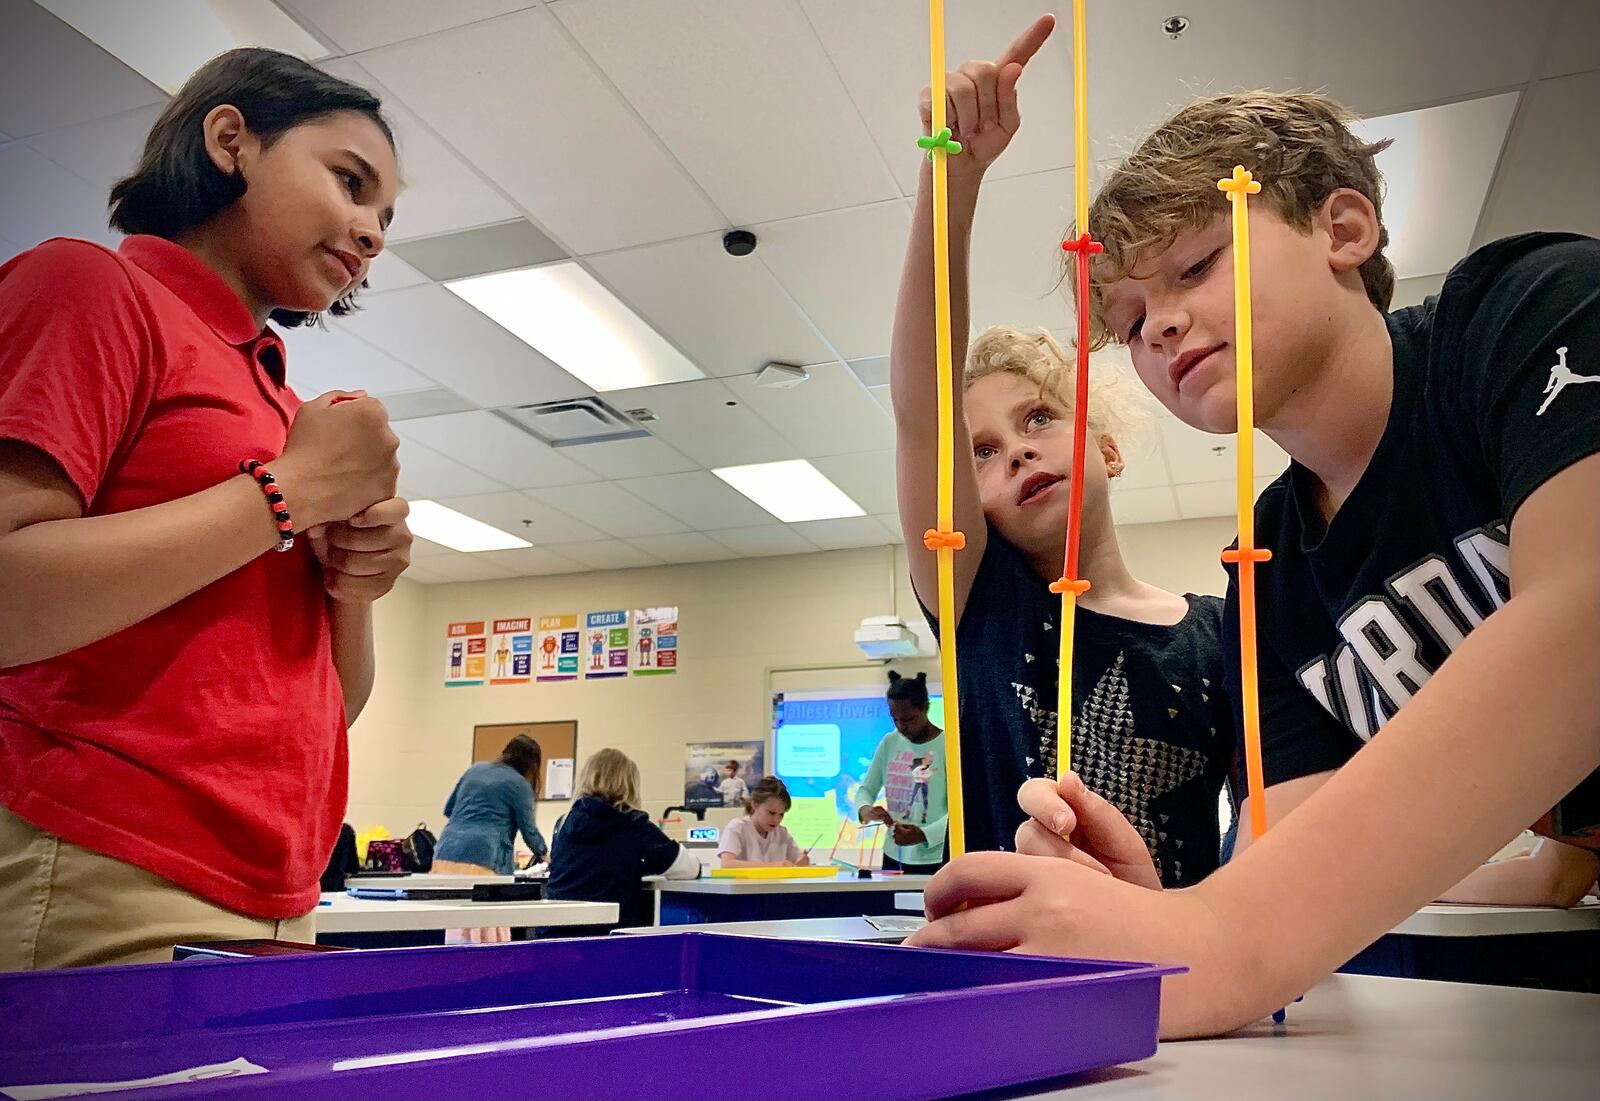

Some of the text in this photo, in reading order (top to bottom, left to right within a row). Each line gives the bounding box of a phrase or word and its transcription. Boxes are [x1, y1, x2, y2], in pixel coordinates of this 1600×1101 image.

[540, 617, 561, 629] PLAN
[590, 613, 620, 625] CREATE
[496, 620, 529, 632] IMAGINE
[835, 702, 882, 719] Tower
